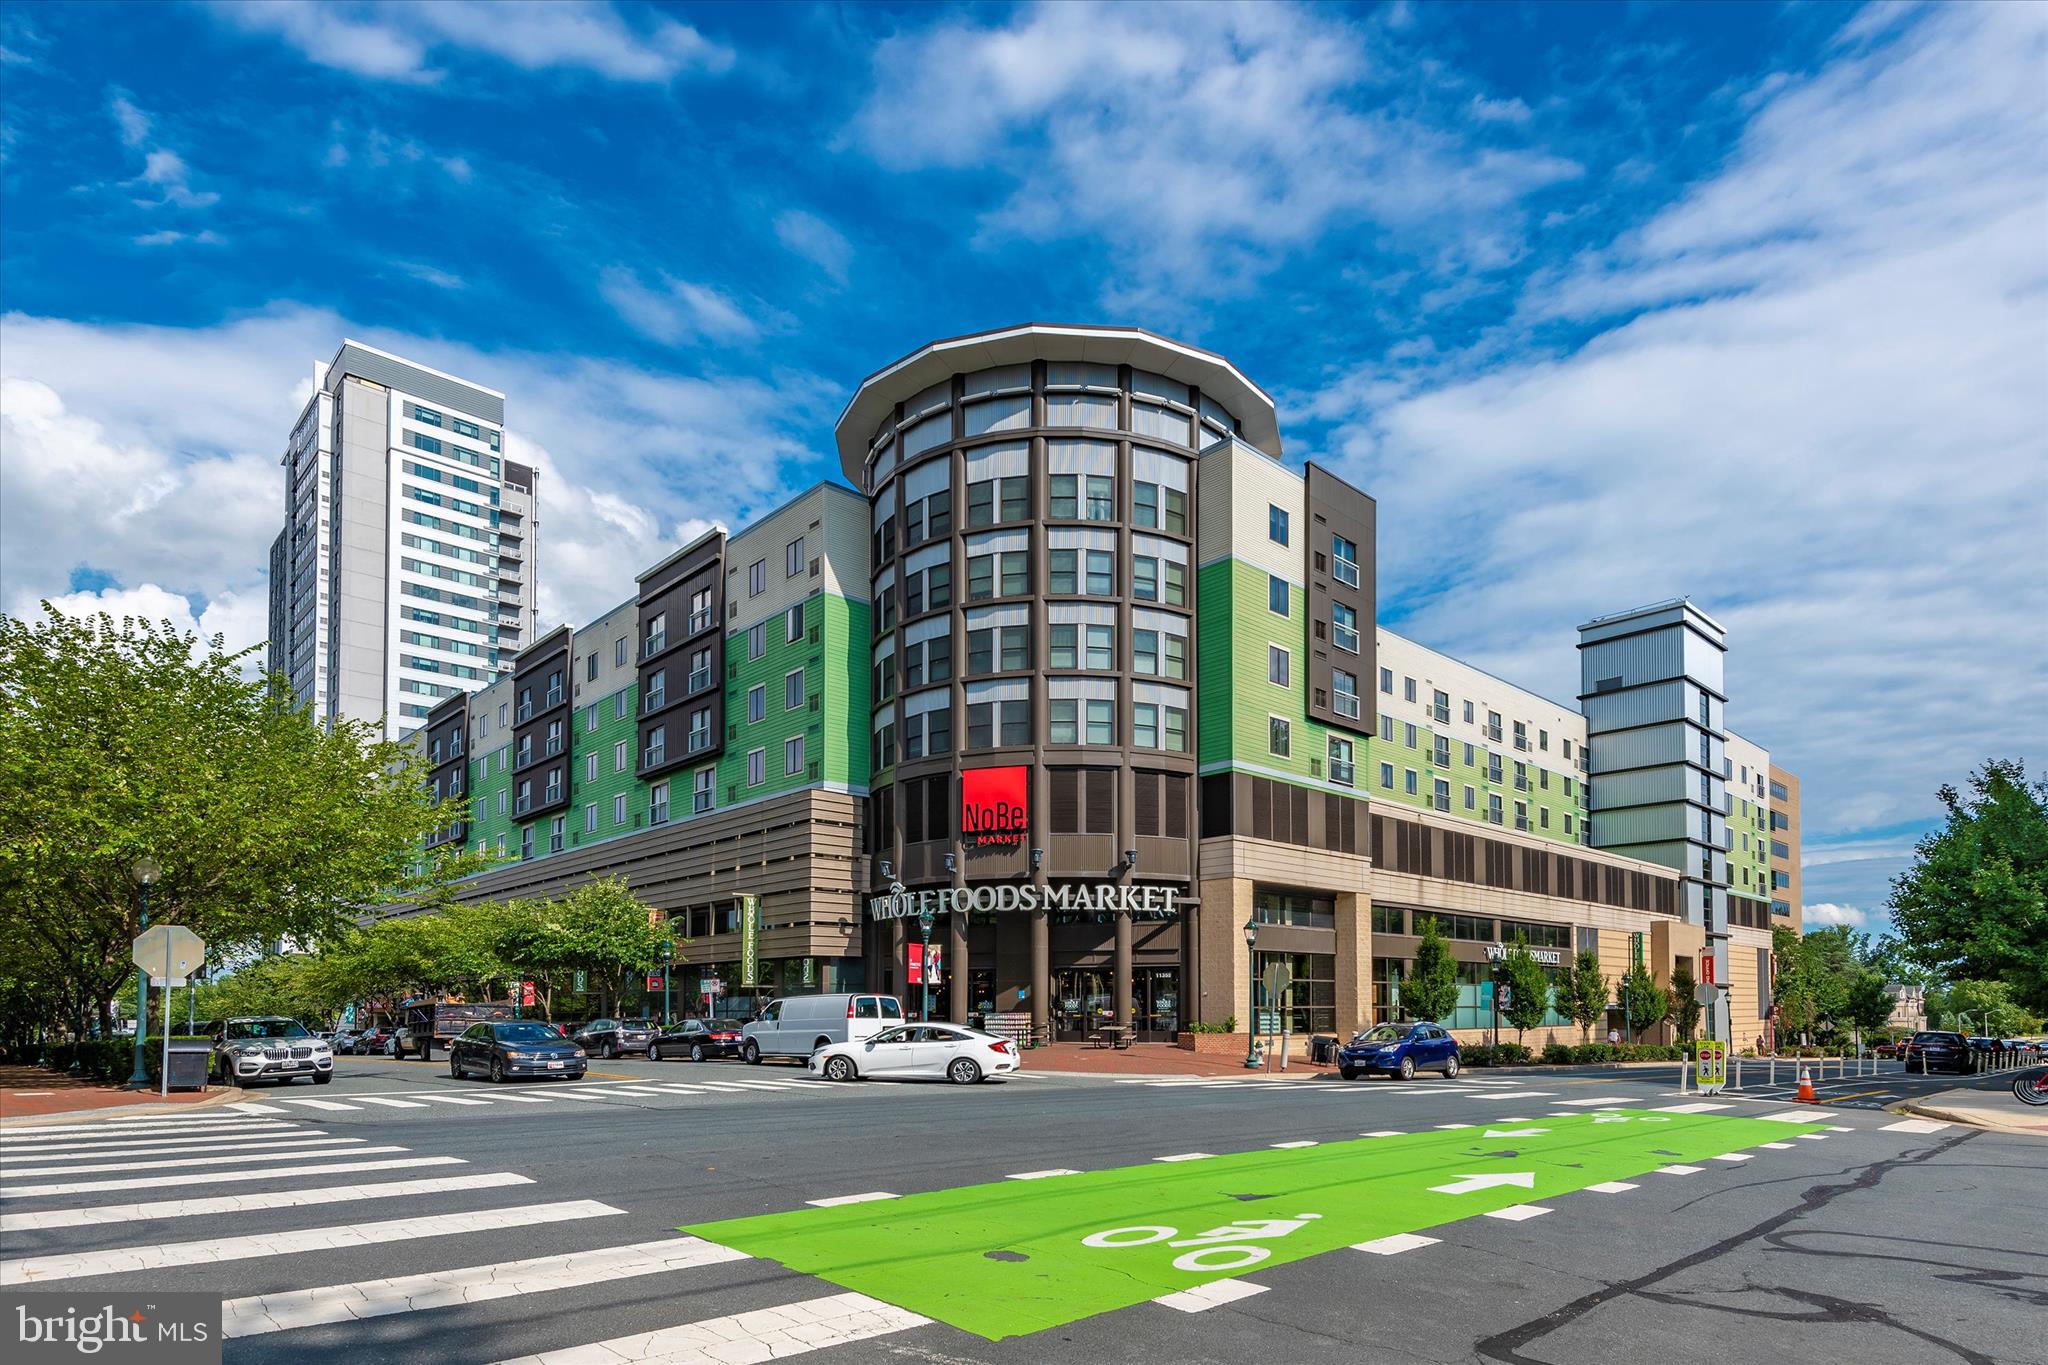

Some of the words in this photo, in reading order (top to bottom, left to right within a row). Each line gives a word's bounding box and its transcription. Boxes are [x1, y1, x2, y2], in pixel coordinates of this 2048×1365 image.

[966, 801, 1023, 831] NoBe
[977, 833, 1026, 845] MARKET
[870, 884, 936, 921] WHOLE
[937, 884, 1038, 913] FOODS
[1041, 884, 1180, 913] MARKET
[747, 897, 756, 939] WHOLE
[1534, 951, 1561, 964] MARKET
